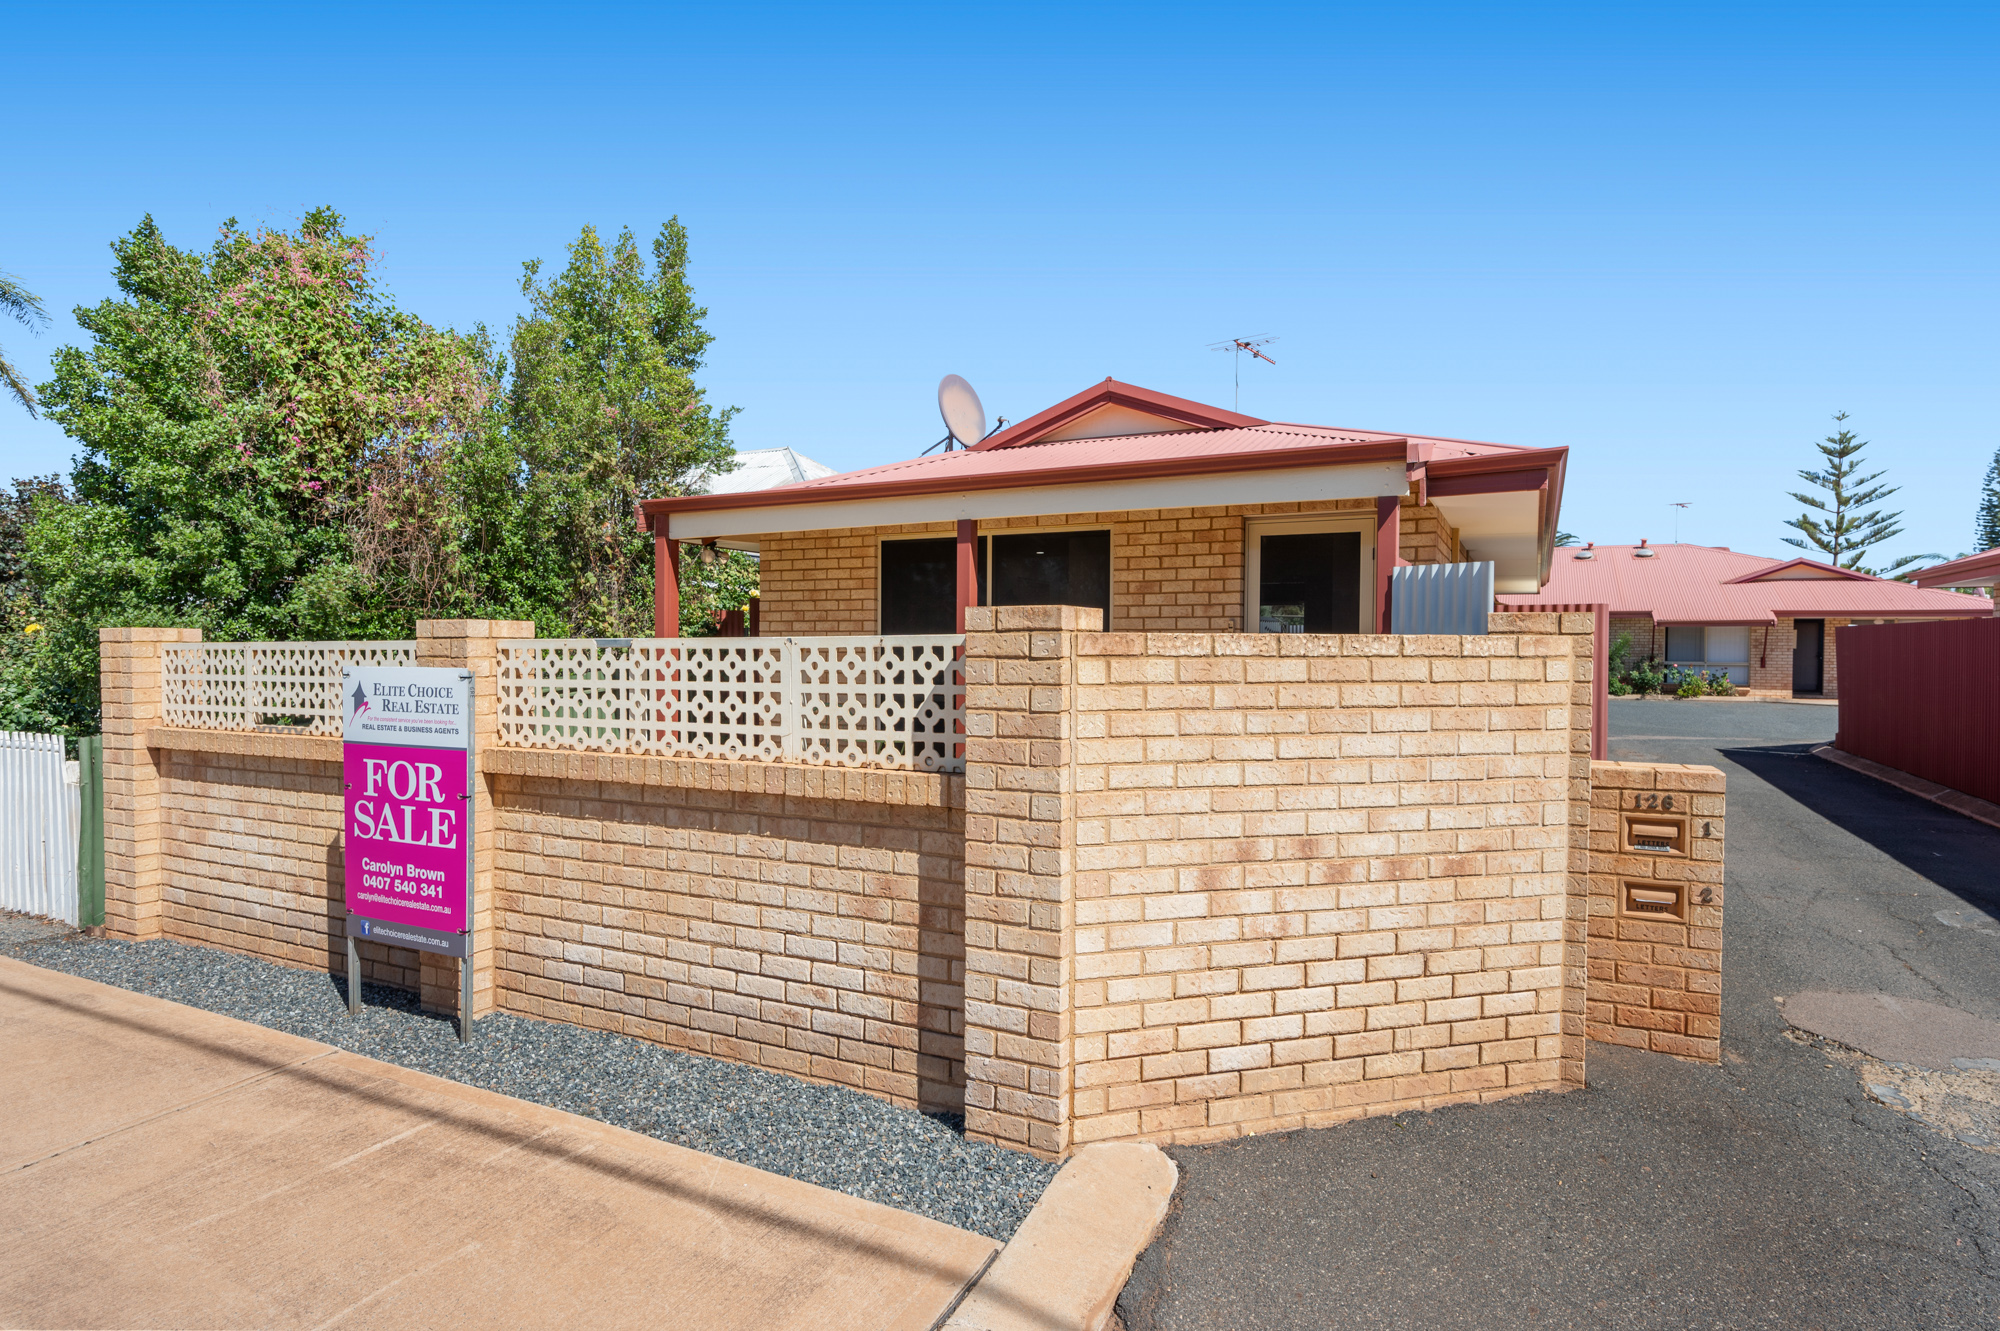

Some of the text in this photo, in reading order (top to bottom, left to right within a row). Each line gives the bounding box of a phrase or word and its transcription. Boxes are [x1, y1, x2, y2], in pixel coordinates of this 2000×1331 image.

[373, 683, 453, 698] ELITE CHOICE
[382, 699, 460, 715] REAL ESTATE
[362, 723, 376, 731] REAL
[377, 724, 397, 732] ESTATE
[404, 725, 433, 734] BUSINESS
[434, 727, 460, 735] AGENTS
[363, 758, 446, 803] FOR
[1634, 793, 1674, 810] 126
[354, 800, 457, 850] SALE
[1702, 821, 1711, 837] 1
[1637, 839, 1670, 847] LETTERS
[362, 857, 446, 882] Carolyn Brown
[363, 874, 443, 899] 0407 540 341
[357, 891, 452, 915] carolyn@elitechoicerealestate.com.au
[1697, 887, 1713, 903] 2
[1636, 903, 1669, 912] LETTERS
[373, 926, 450, 948] elitechoicerealestate.com.au
